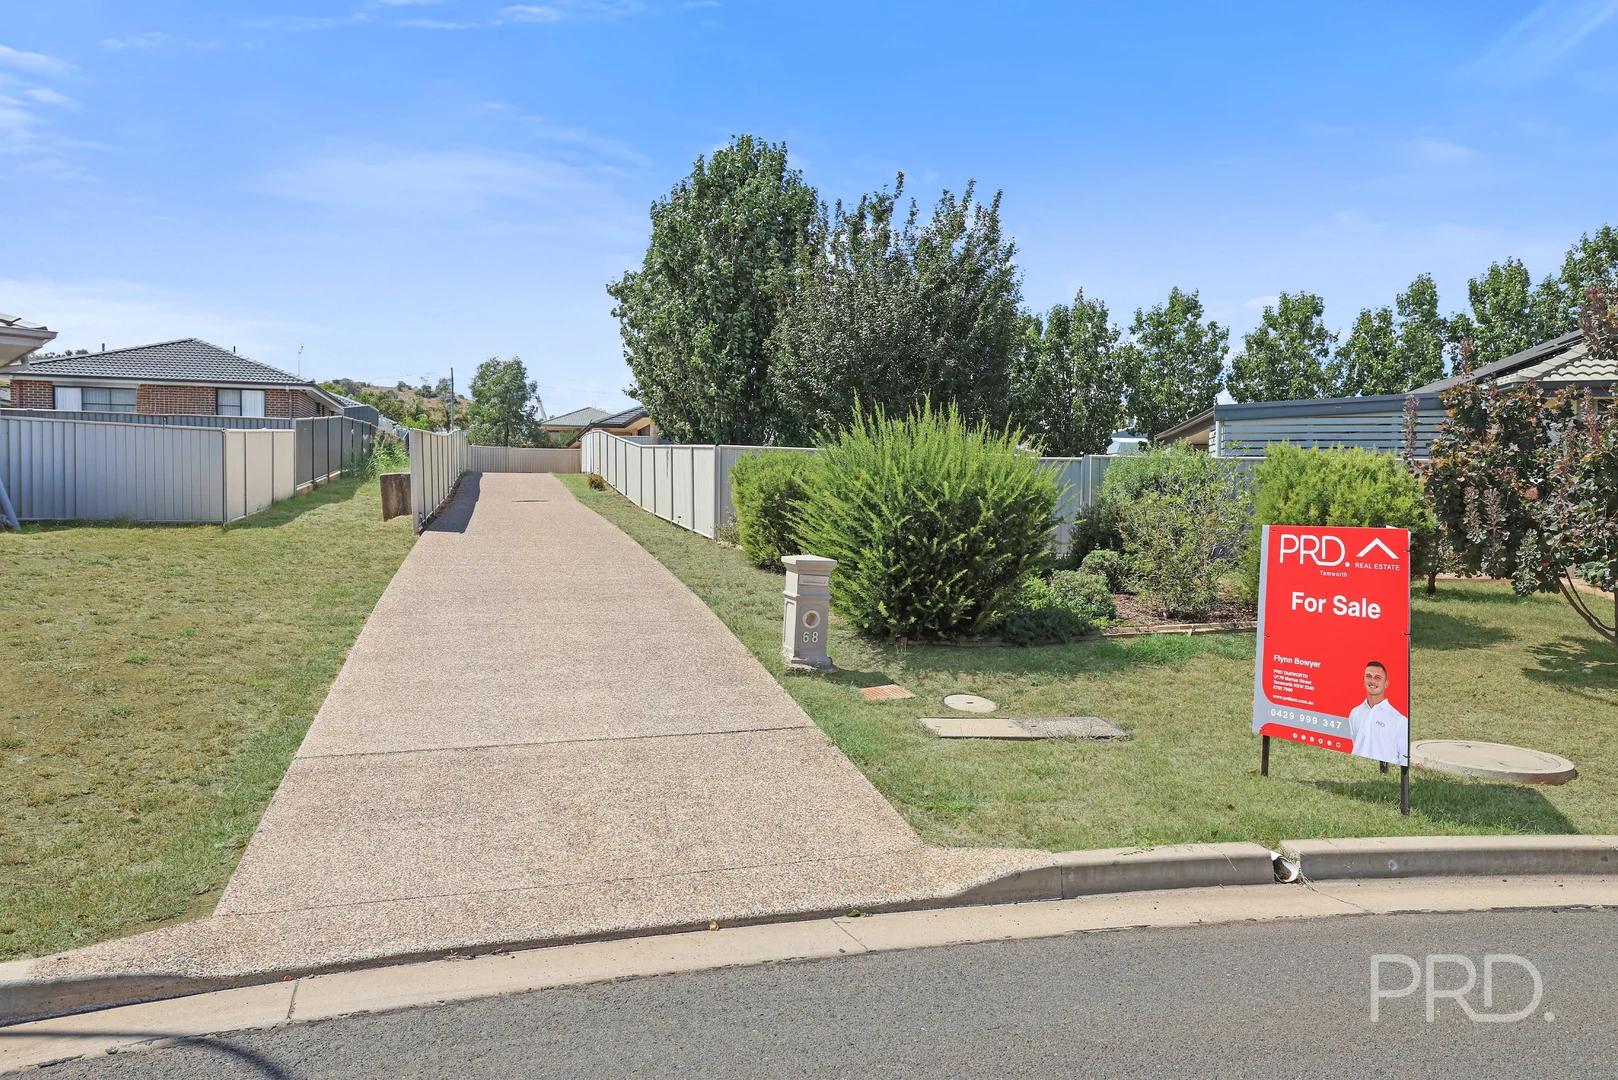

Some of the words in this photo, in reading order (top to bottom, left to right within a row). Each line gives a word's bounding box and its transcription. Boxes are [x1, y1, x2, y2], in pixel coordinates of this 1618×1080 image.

[1374, 563, 1400, 571] ESTATE
[1291, 592, 1327, 614] For
[1333, 595, 1381, 619] Sale
[803, 631, 818, 643] 68
[1273, 654, 1292, 664] Flynn
[1294, 657, 1321, 668] Bowyer
[1271, 709, 1295, 720] 0429
[1299, 714, 1318, 725] 999
[1322, 719, 1342, 729] 347
